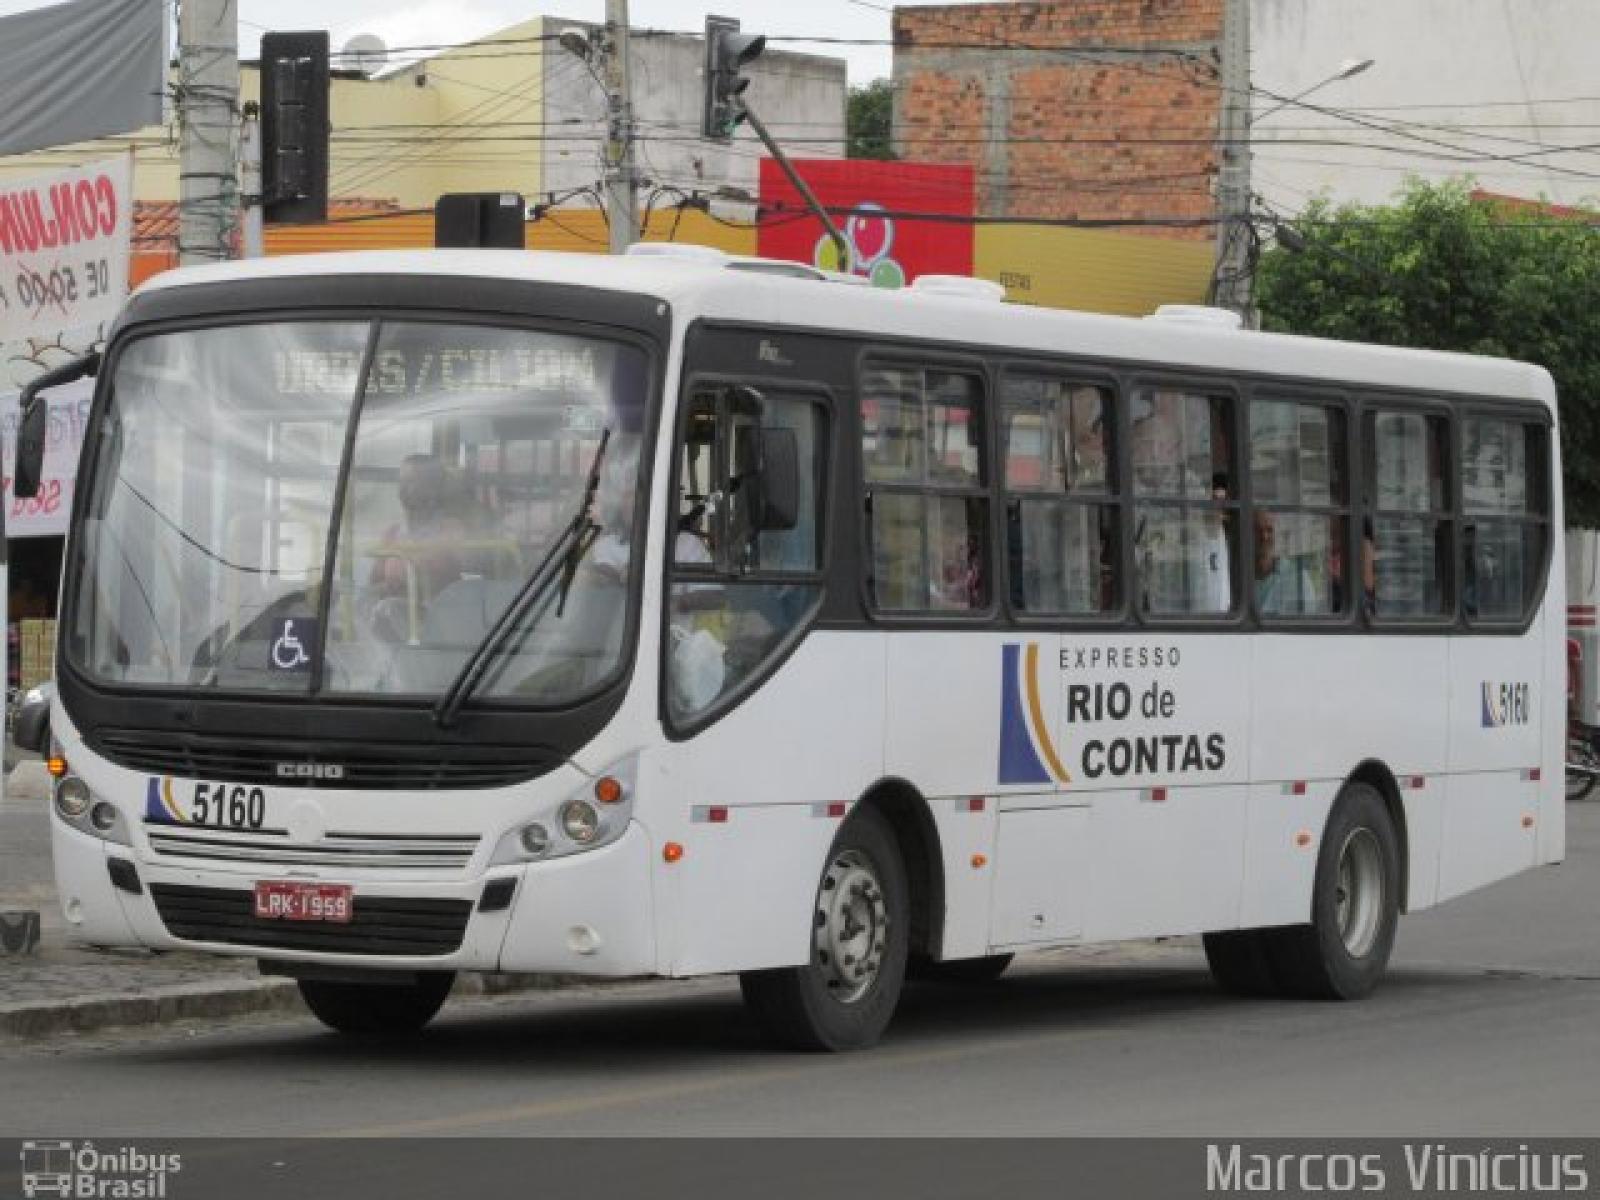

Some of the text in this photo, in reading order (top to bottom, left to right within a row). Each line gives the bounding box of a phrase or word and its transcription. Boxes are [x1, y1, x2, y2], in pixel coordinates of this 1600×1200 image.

[1059, 647, 1181, 670] EXPRESSO
[1067, 681, 1176, 722] RIO de
[1082, 733, 1225, 778] CONTAS
[192, 784, 265, 828] 5160
